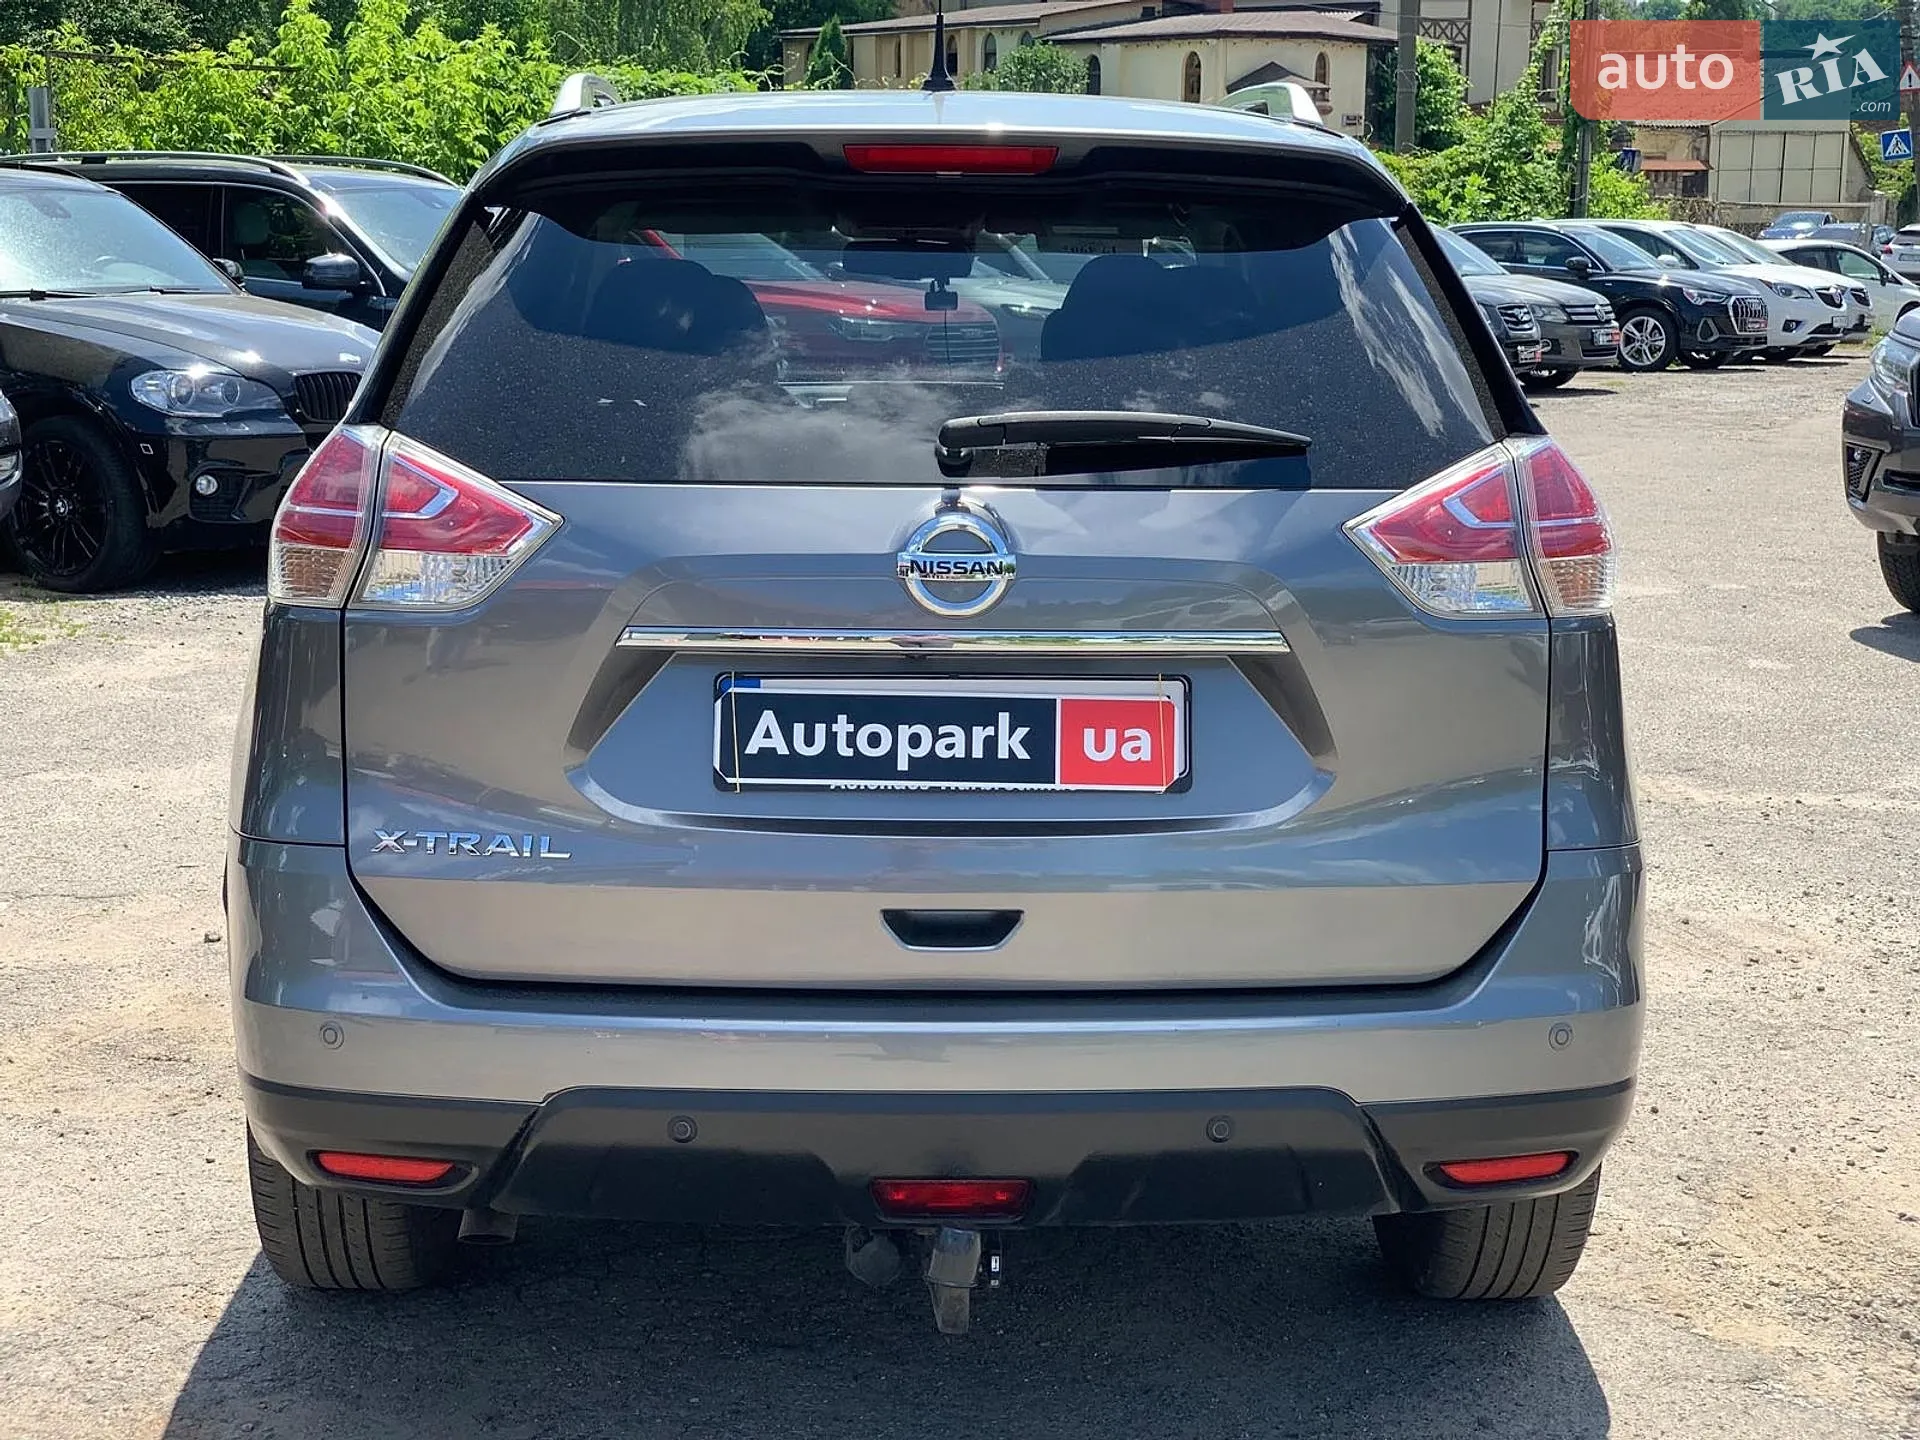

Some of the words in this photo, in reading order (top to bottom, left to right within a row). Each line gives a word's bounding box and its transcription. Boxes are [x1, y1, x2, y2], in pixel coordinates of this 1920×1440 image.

[909, 560, 1004, 576] NISSAN
[744, 709, 1032, 771] Autopark
[1083, 726, 1152, 762] ua
[370, 828, 572, 859] X-TRAIL
